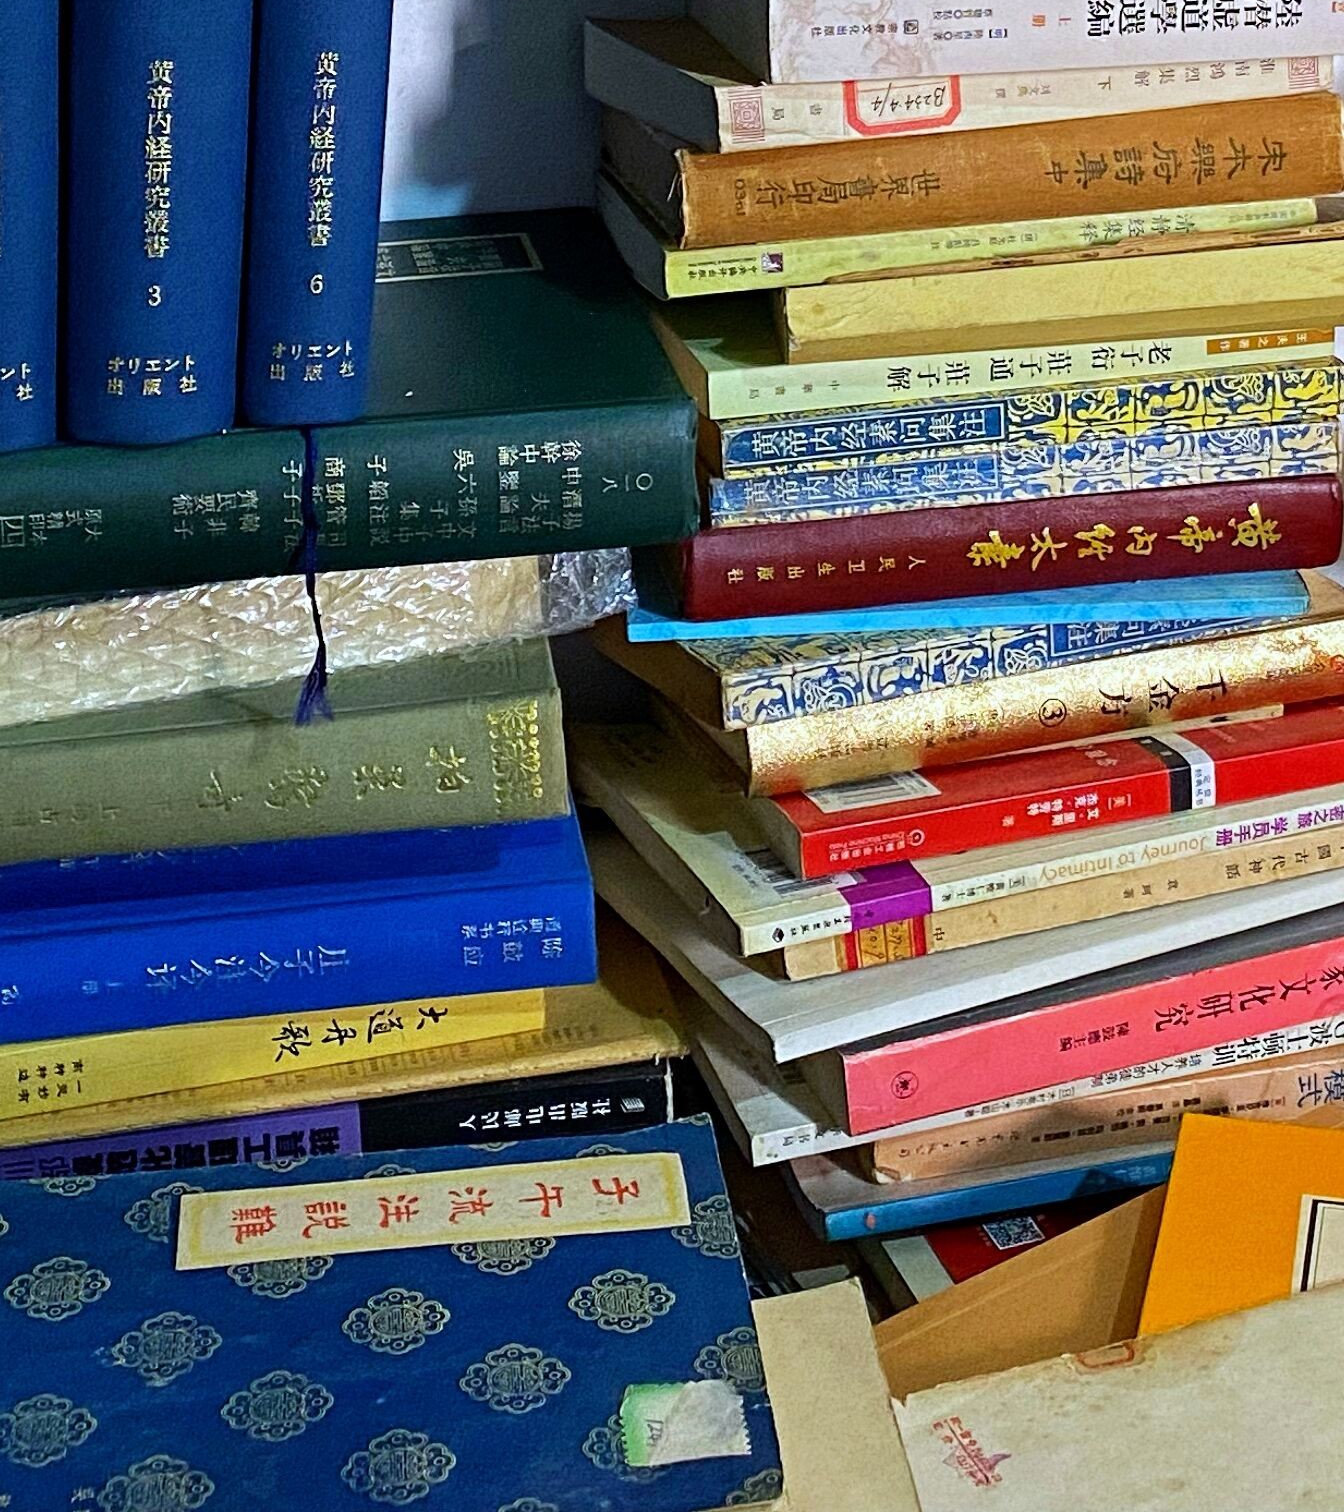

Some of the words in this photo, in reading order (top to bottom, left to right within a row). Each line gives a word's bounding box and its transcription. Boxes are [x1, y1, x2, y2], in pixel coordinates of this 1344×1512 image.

[309, 274, 323, 294] 6
[147, 285, 162, 306] 3
[271, 340, 355, 361] オリエント
[107, 353, 196, 373] オリエント
[270, 361, 355, 382] 出版社
[107, 374, 198, 396] 出版社
[1099, 673, 1229, 718] 千金方
[1217, 813, 1288, 847] 学员手册
[1139, 834, 1207, 863] Journey
[1039, 852, 1114, 882] Intimacy
